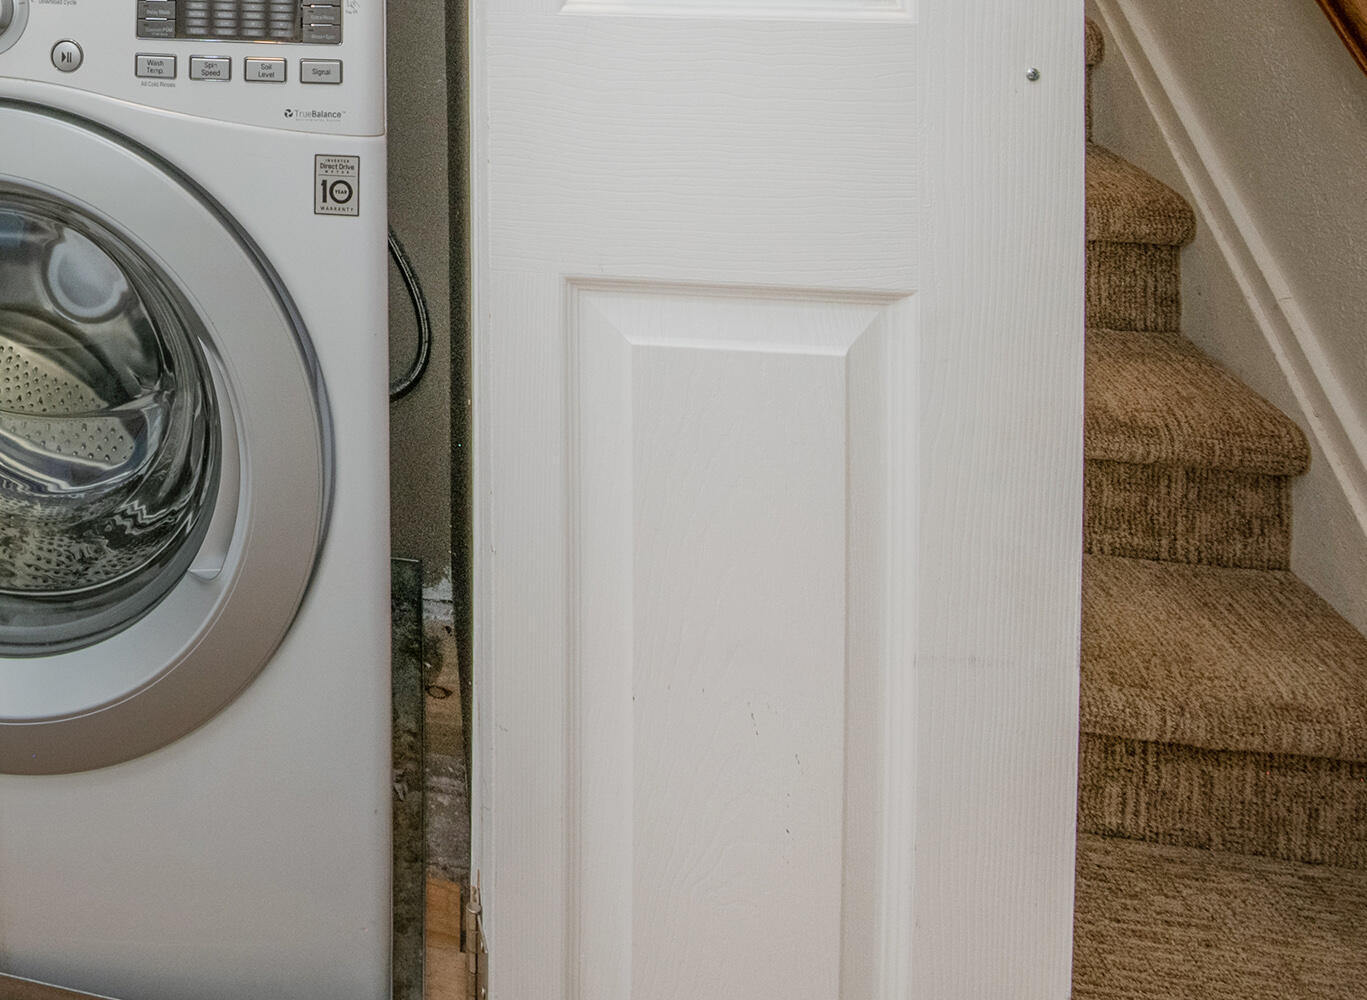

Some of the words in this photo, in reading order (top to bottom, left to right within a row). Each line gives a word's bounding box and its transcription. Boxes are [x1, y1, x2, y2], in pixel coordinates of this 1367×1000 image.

[146, 59, 164, 67] Wash
[201, 69, 220, 77] Speed
[312, 68, 331, 77] Signal
[319, 162, 338, 170] Direct
[339, 163, 355, 171] Drive
[320, 179, 353, 204] 10
